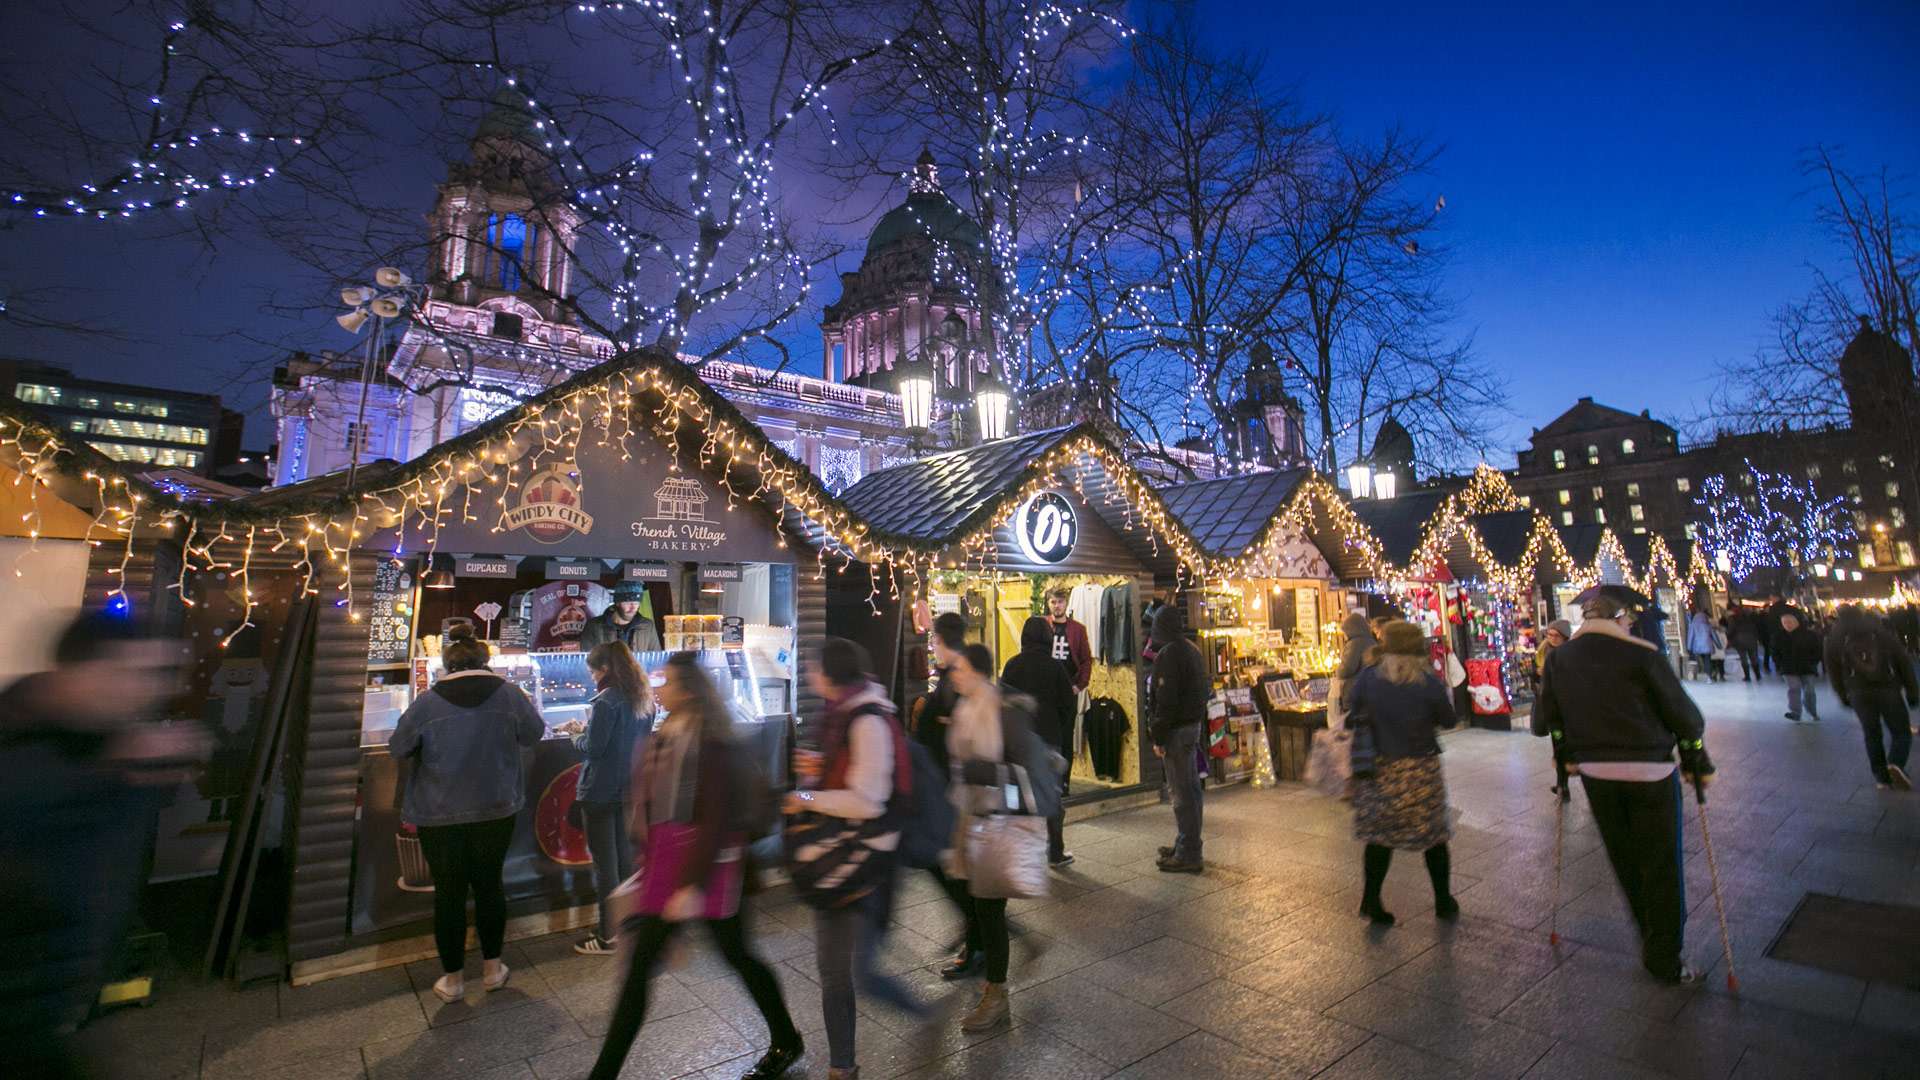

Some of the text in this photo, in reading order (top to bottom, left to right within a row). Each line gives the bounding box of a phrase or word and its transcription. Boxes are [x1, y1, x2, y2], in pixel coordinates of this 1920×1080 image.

[510, 505, 590, 529] WINDY CITY
[631, 521, 728, 546] French Village
[466, 563, 507, 574] CUPCAKES
[560, 566, 588, 576] DONUTS
[632, 568, 668, 578] BROWNIES
[703, 569, 738, 578] MACARONS
